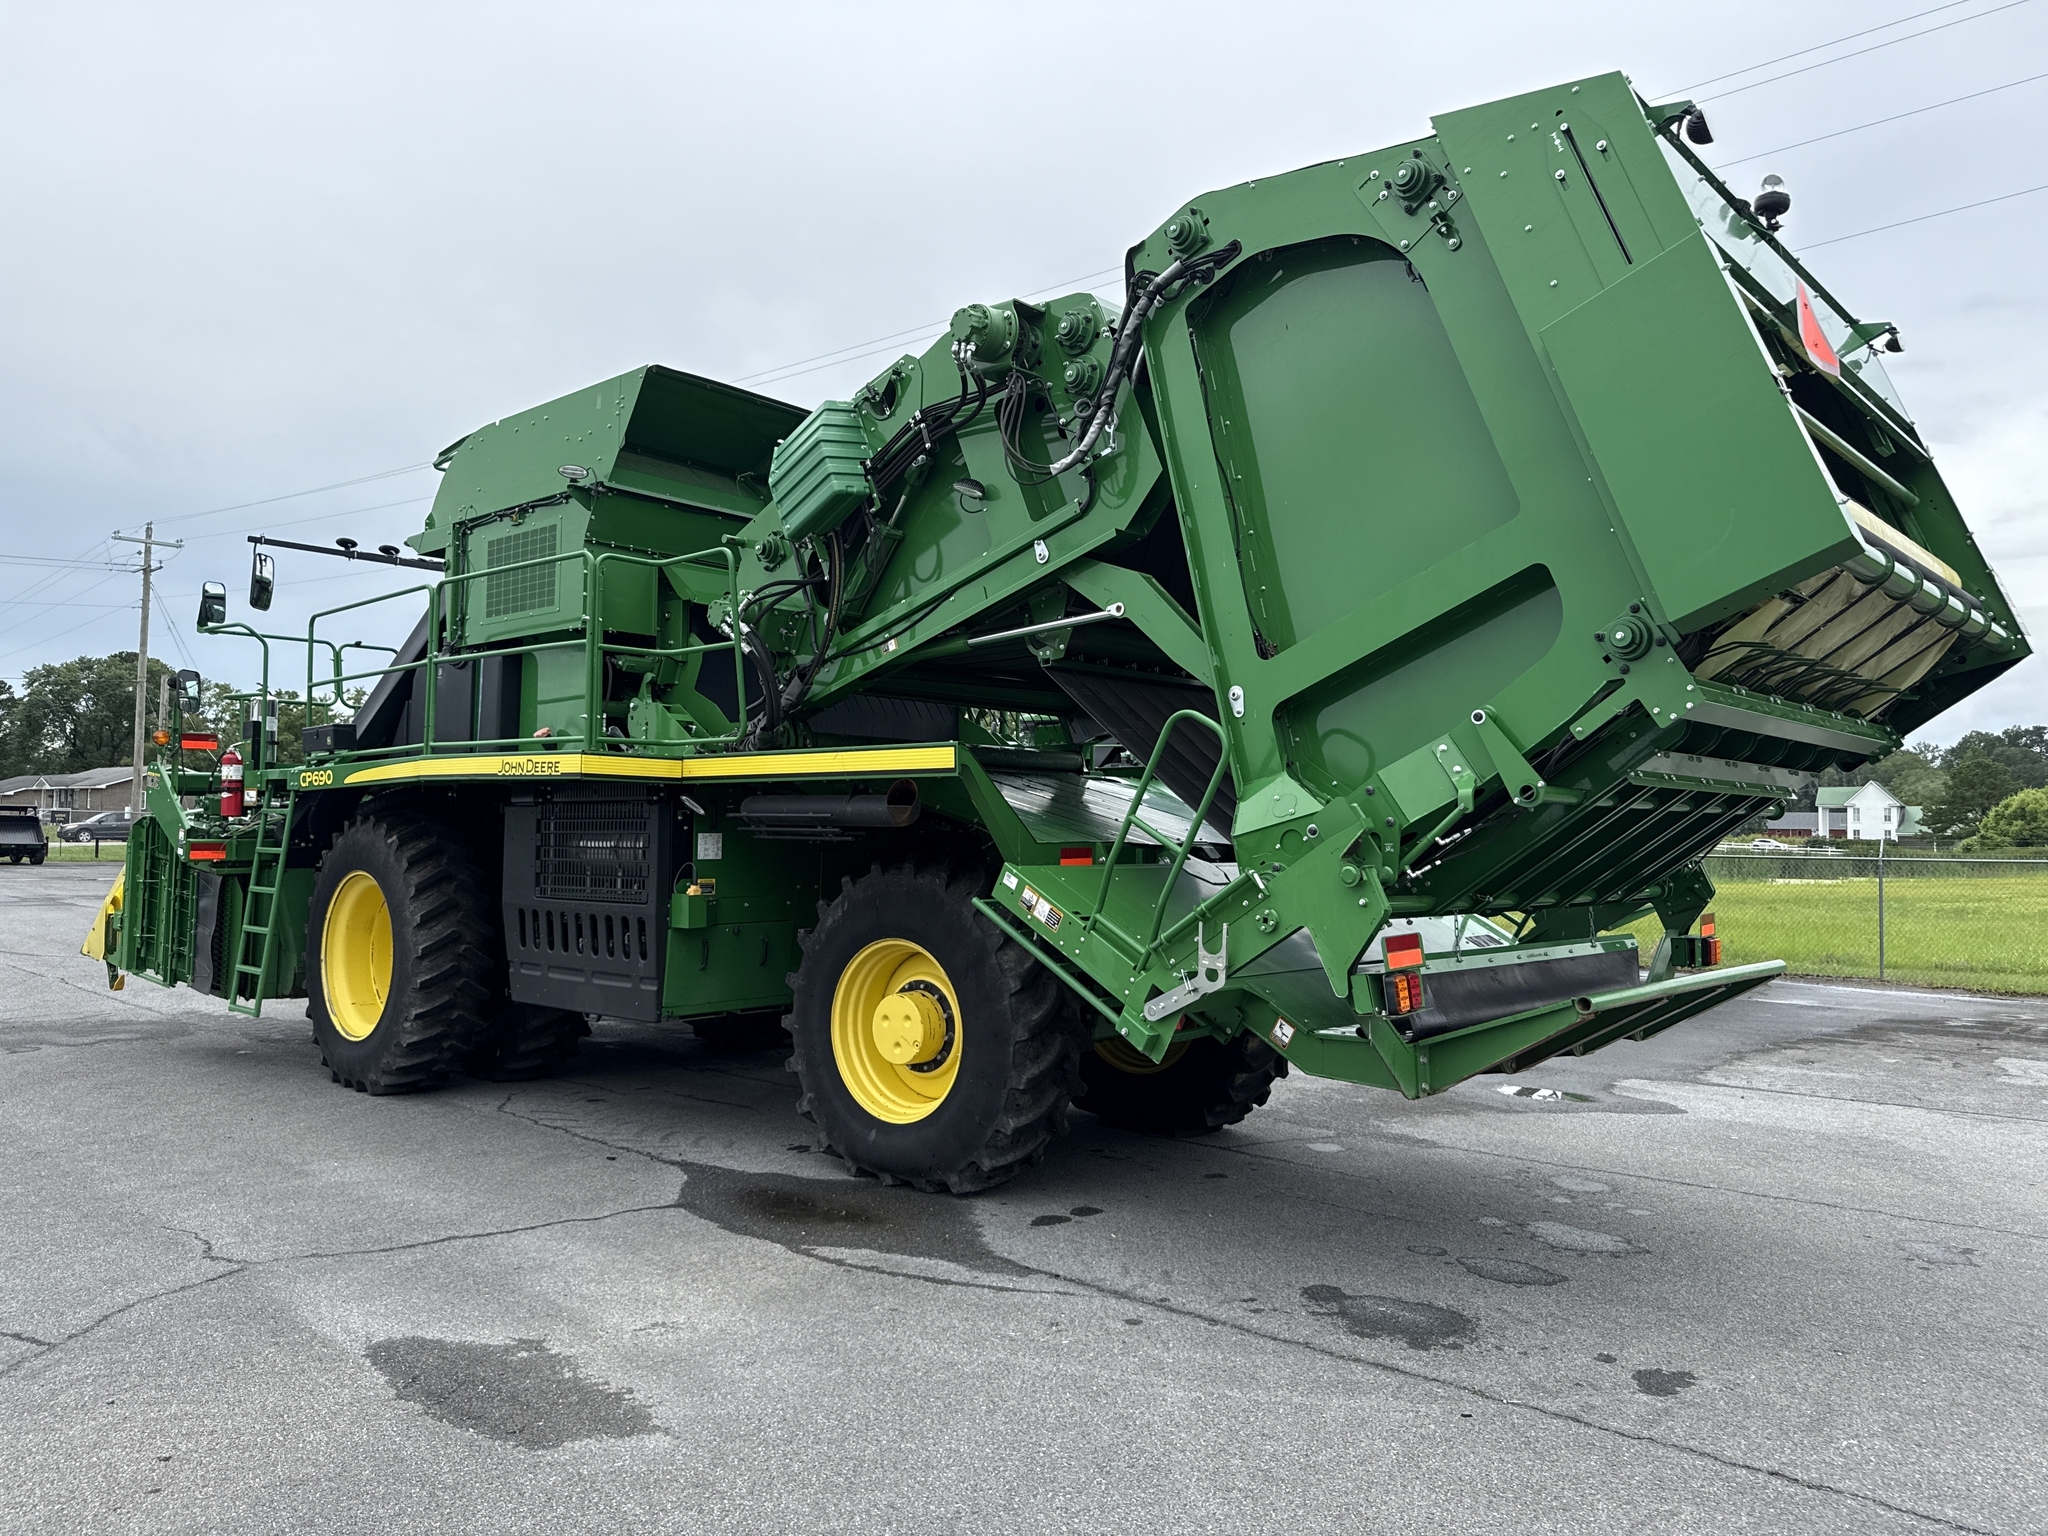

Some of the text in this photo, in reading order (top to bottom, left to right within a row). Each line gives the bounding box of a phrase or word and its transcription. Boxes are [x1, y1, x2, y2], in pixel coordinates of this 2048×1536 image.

[497, 758, 561, 774] JOHN DEERE
[300, 769, 333, 787] CP690
